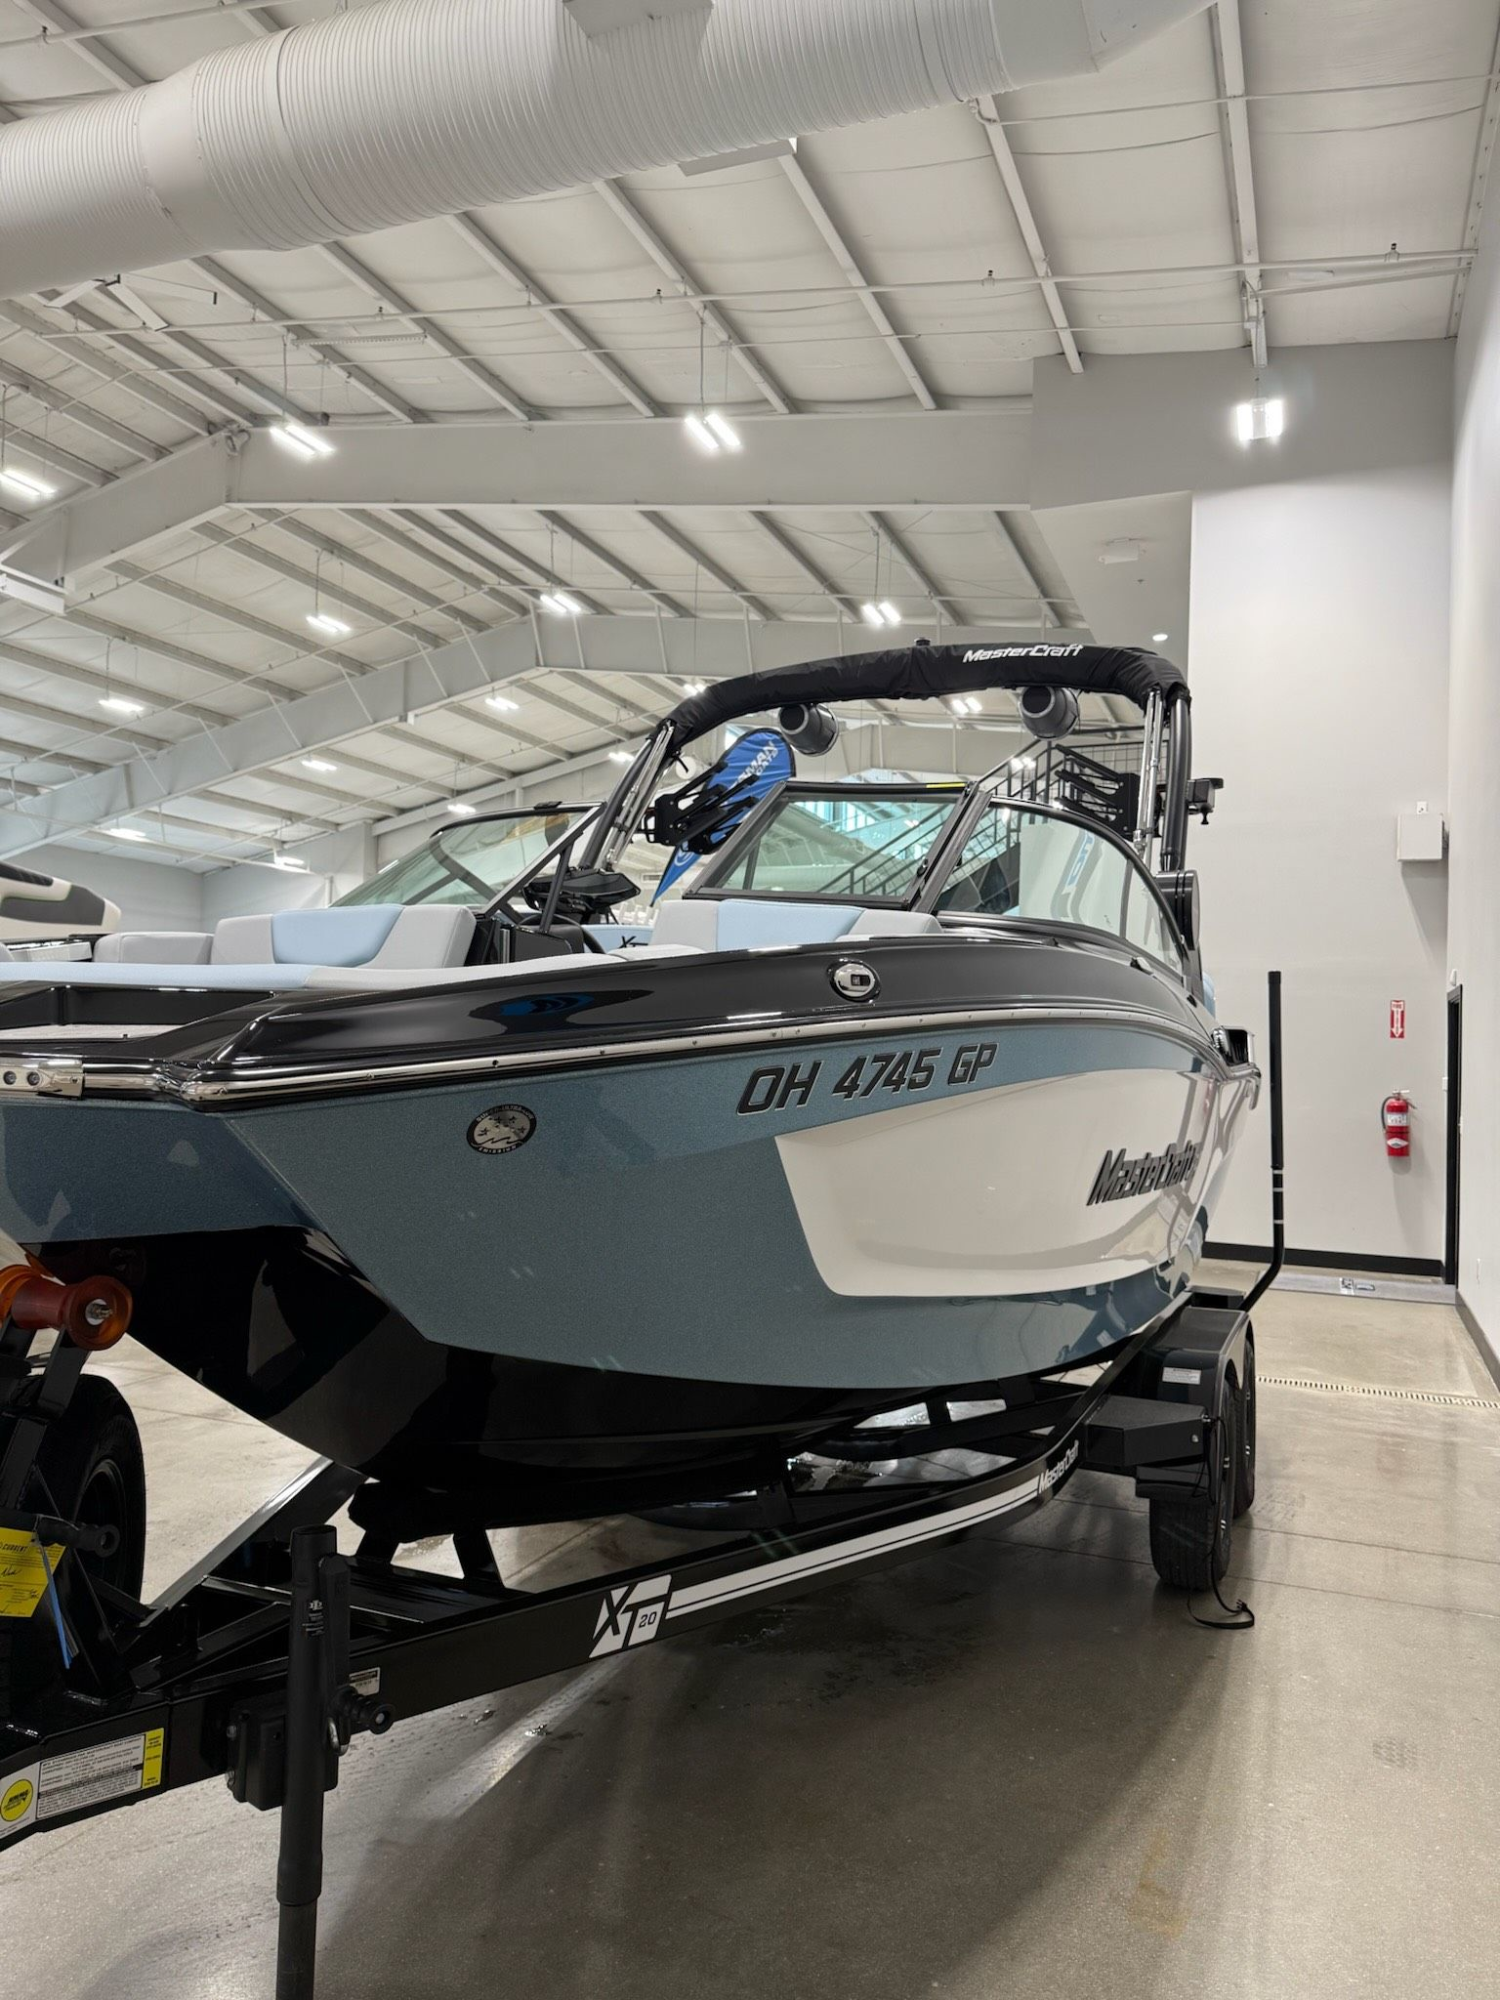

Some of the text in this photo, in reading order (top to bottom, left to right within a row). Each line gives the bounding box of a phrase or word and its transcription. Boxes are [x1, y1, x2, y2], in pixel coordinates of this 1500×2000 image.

[962, 643, 1083, 663] MasterCraft
[736, 1042, 999, 1116] OH 4745 GP
[1038, 1440, 1079, 1494] MasterCraft
[590, 1580, 670, 1652] XT 20
